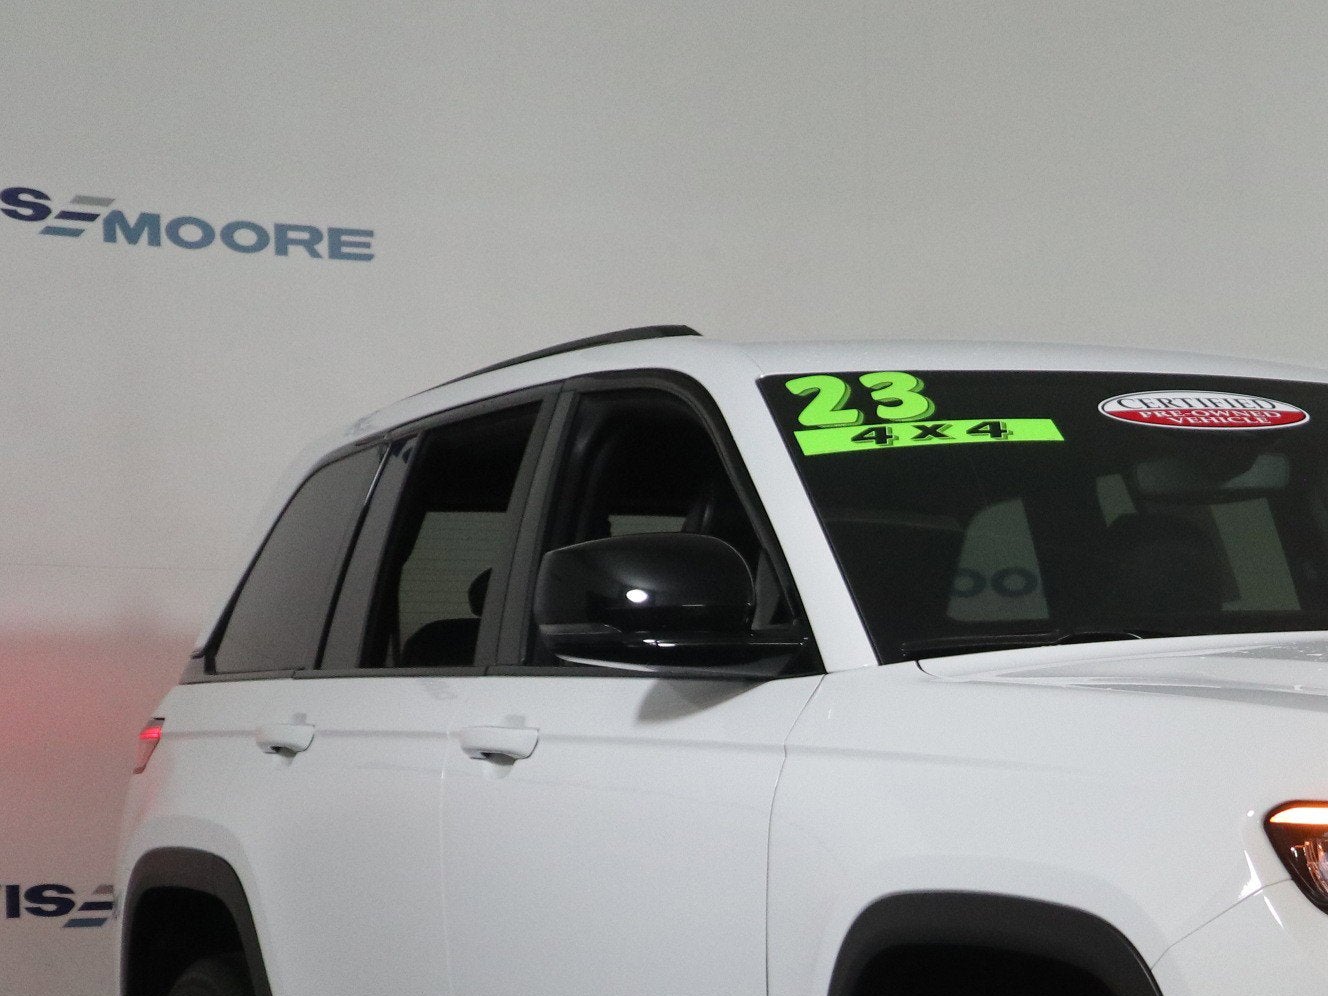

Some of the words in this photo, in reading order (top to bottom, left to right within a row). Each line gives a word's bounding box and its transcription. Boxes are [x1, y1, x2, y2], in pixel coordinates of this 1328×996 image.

[102, 209, 375, 262] MOORE
[784, 371, 936, 427] 23
[1116, 397, 1276, 410] CERTIFIED
[1139, 408, 1282, 419] PRE-OWNED
[1167, 416, 1272, 425] VEHICLE
